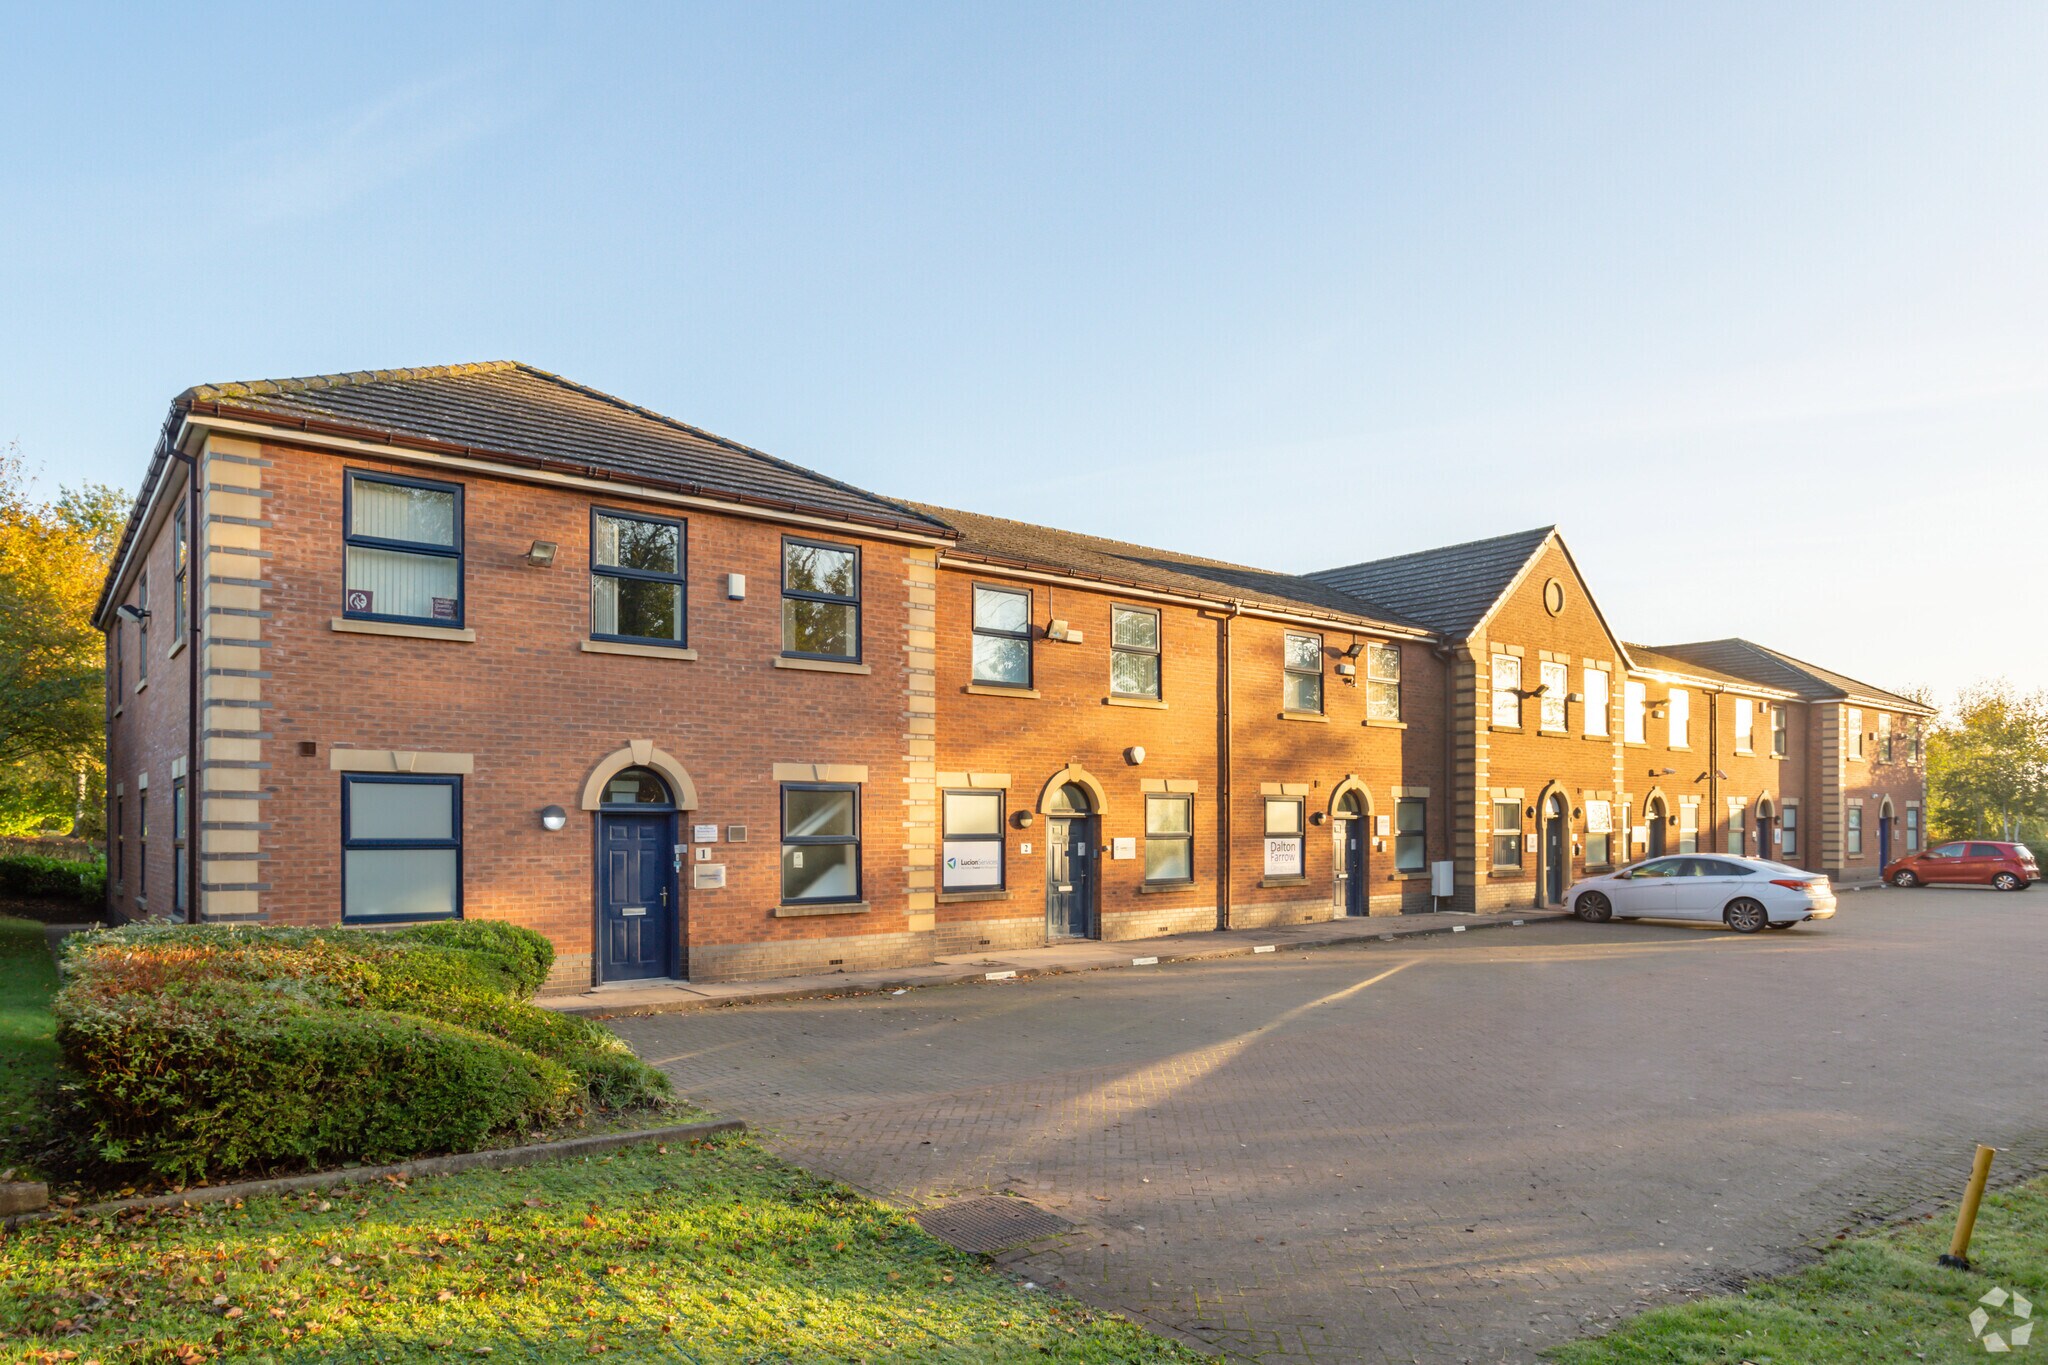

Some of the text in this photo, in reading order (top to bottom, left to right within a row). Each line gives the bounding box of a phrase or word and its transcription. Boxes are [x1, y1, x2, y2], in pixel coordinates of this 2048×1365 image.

[1024, 844, 1029, 853] 2
[1271, 841, 1296, 852] Dalton
[702, 849, 706, 859] 1
[1270, 852, 1296, 862] Farrow
